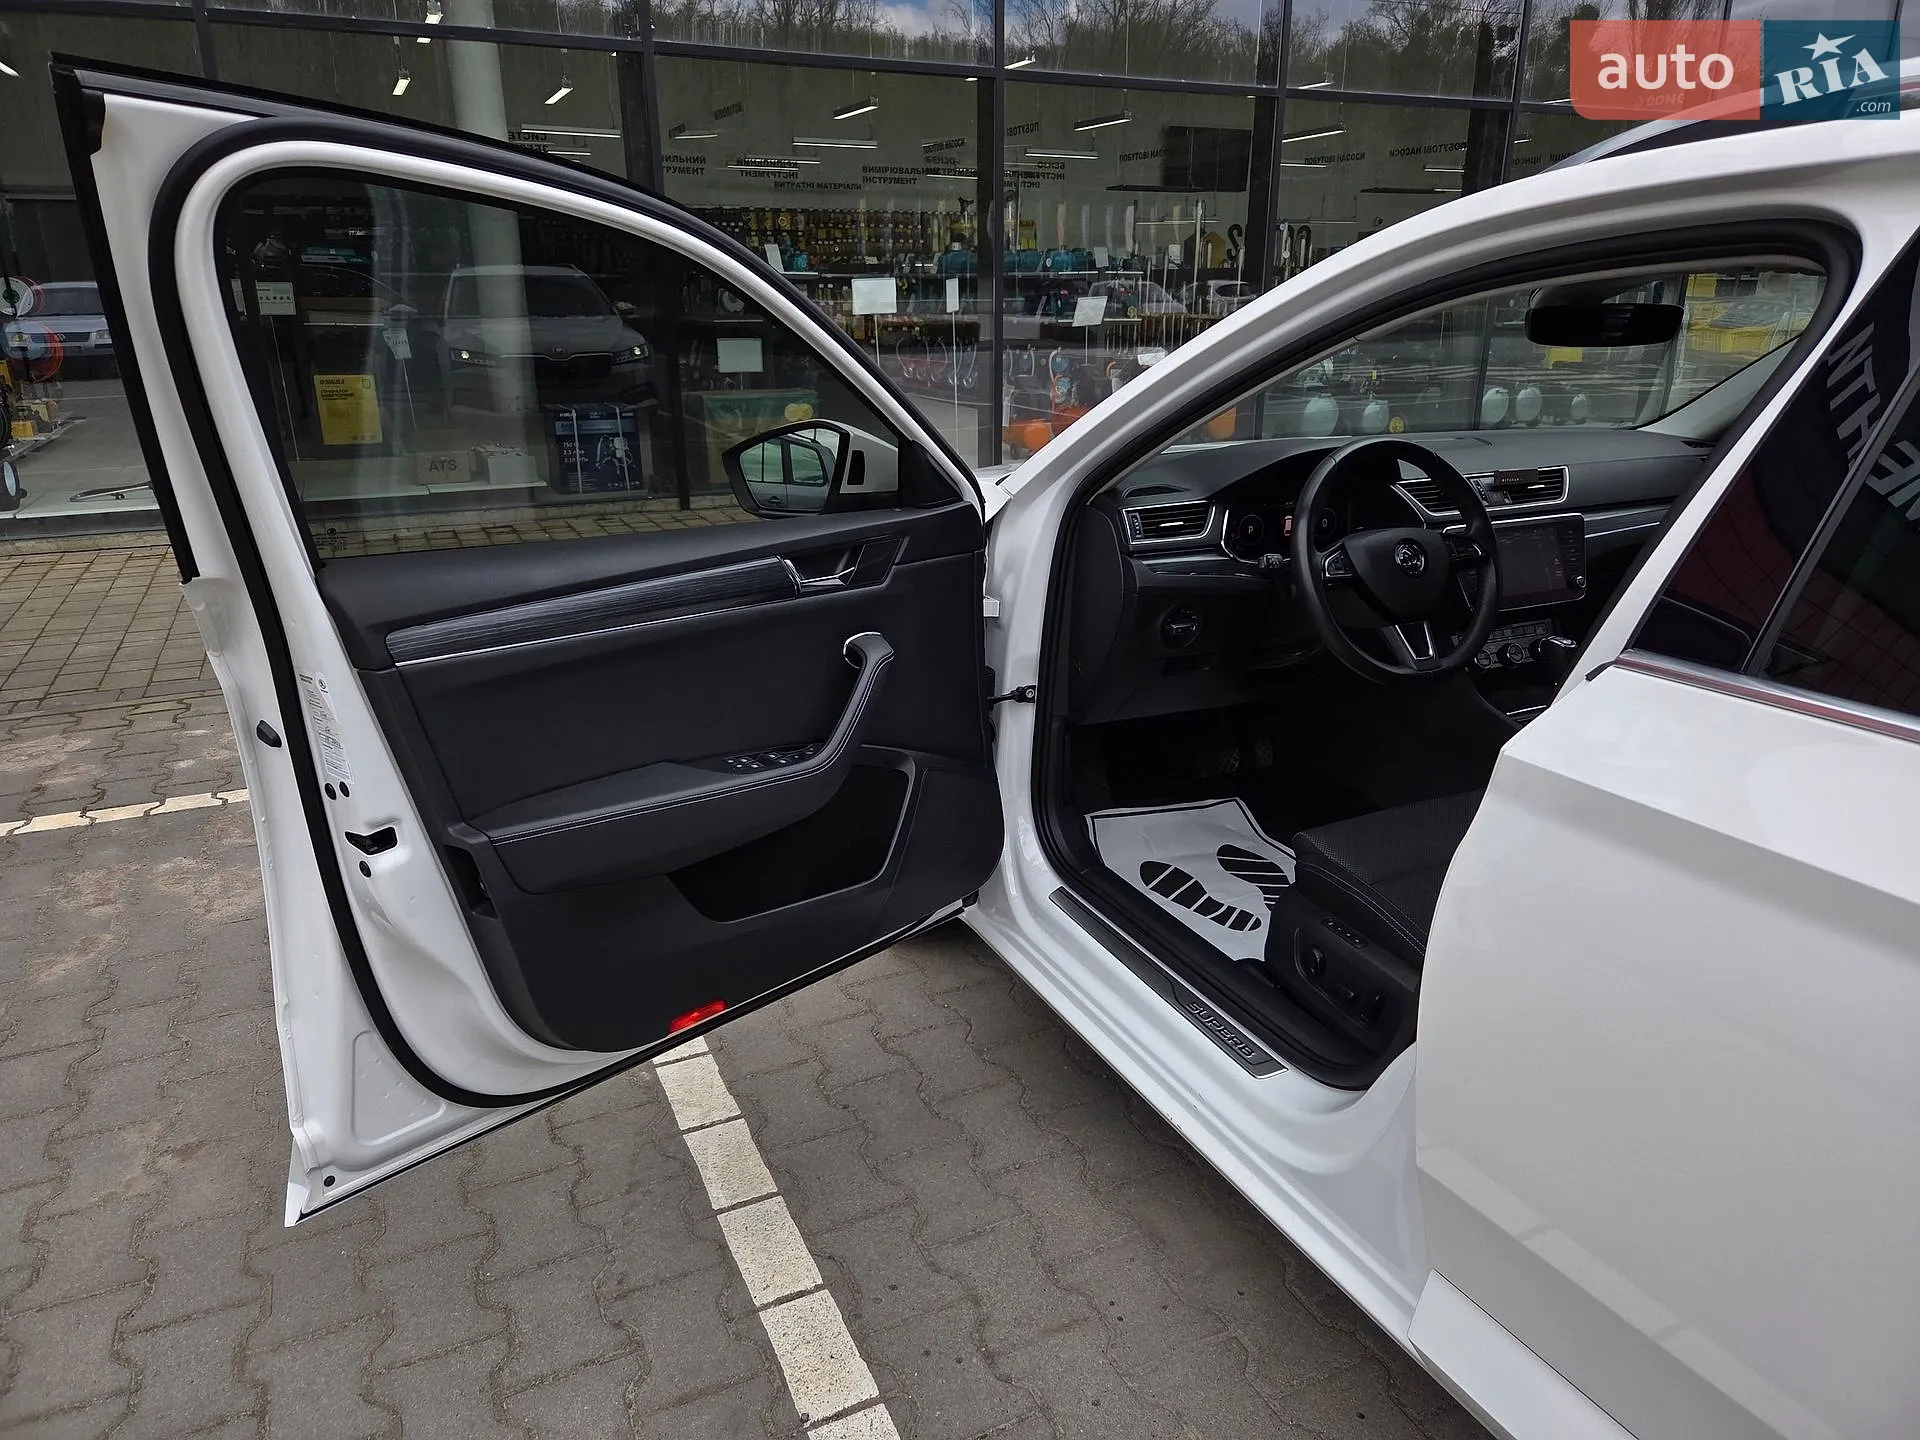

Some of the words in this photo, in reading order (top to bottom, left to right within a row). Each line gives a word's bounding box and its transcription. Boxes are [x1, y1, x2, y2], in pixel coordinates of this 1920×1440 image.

[662, 153, 706, 164] ИЛЬНИЙ
[429, 459, 458, 472] ATS
[1186, 1002, 1256, 1059] SUPERB
